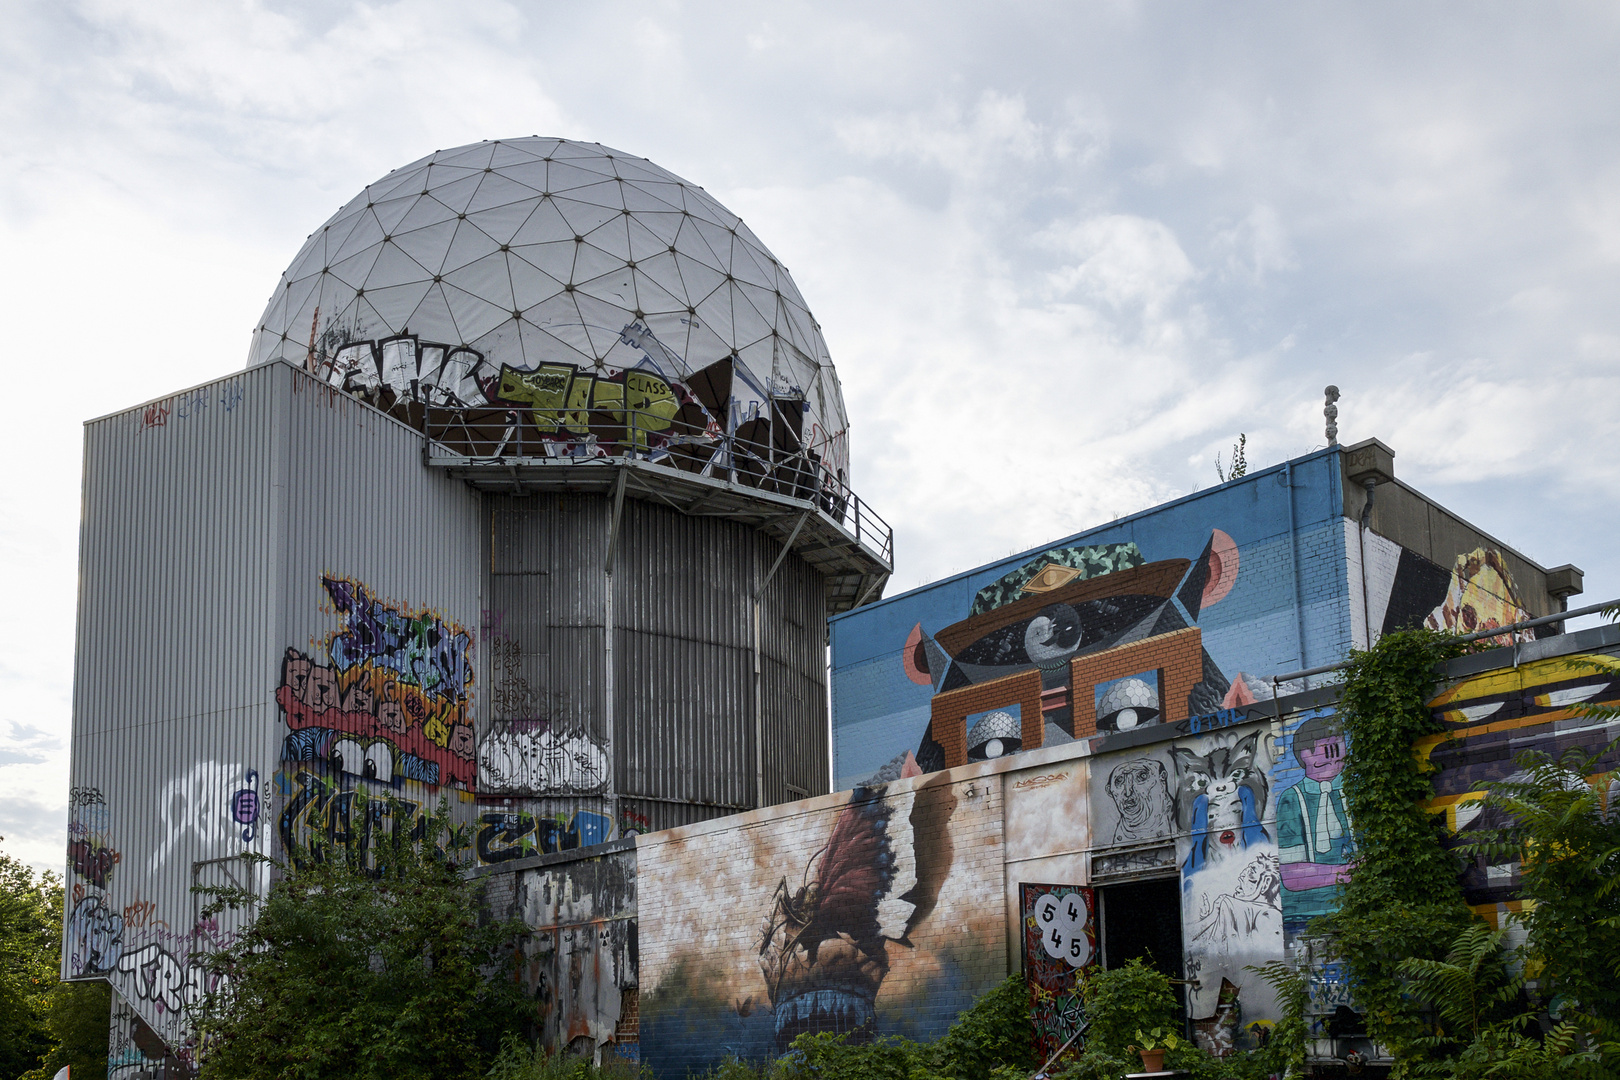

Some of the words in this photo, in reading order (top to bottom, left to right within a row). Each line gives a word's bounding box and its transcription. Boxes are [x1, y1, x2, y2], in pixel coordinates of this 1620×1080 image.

[627, 377, 666, 395] CLASS
[503, 814, 518, 824] ONE
[1042, 903, 1056, 922] 5
[1067, 902, 1078, 922] 4
[1050, 928, 1062, 949] 4
[1070, 938, 1080, 957] 5
